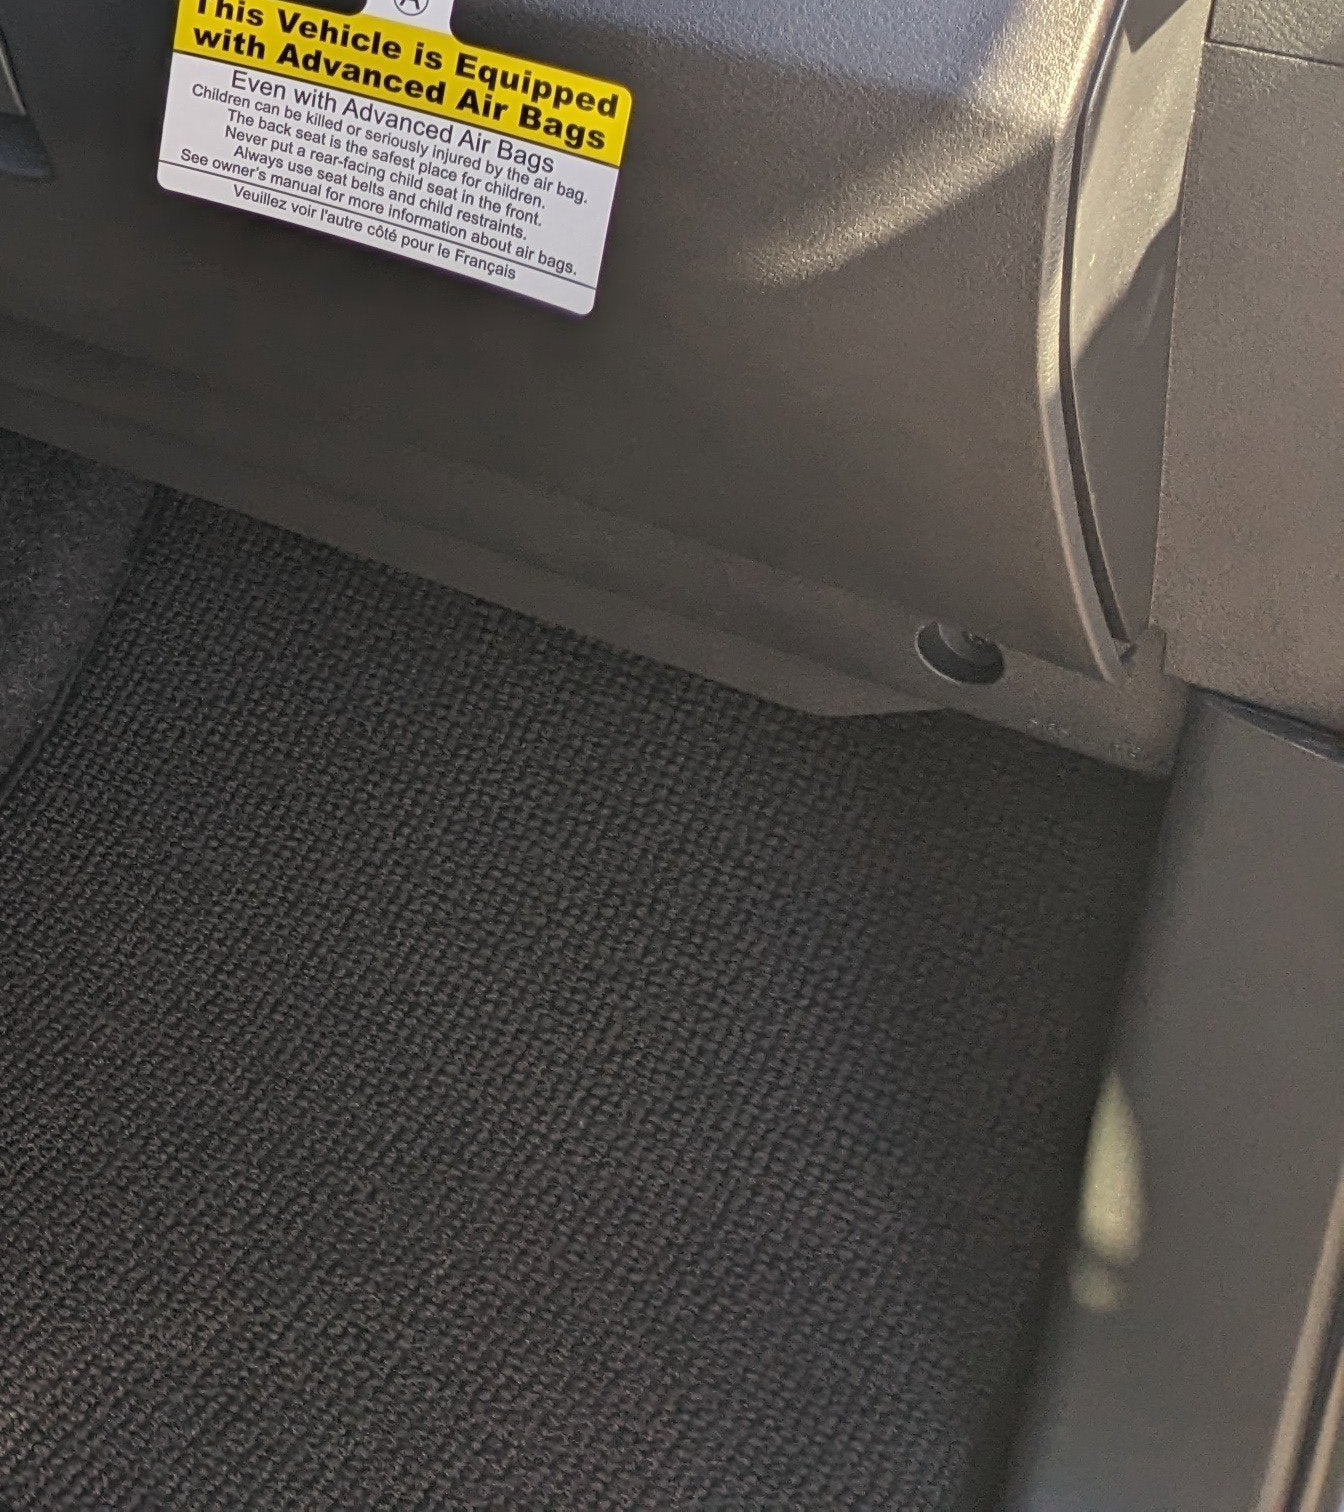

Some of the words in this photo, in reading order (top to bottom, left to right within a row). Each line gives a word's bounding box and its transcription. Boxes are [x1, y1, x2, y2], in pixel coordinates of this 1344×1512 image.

[193, 27, 266, 61] with
[276, 43, 446, 106] Advanced
[455, 88, 510, 122] Air
[518, 103, 607, 150] Bags
[277, 8, 402, 60] Vehicle
[413, 41, 443, 71] is
[454, 52, 619, 120] Equipped
[192, 83, 251, 109] Children
[254, 100, 280, 116] can
[284, 104, 302, 122] be
[306, 109, 343, 133] killed
[346, 125, 362, 137] or
[365, 129, 429, 157] seriously
[432, 146, 481, 171] injured
[485, 162, 504, 181] by
[506, 167, 530, 186] the
[533, 173, 553, 193] air
[556, 181, 588, 206] bag.
[227, 109, 254, 127] The
[258, 114, 292, 137] back
[295, 127, 326, 146] seat
[329, 134, 342, 149] is
[345, 138, 368, 157] the
[372, 146, 416, 170] safest
[419, 160, 458, 183] place
[461, 171, 482, 189] for
[485, 179, 546, 209] children.
[231, 69, 286, 100] Even
[294, 87, 337, 113] with
[341, 97, 454, 144] Advanced
[458, 129, 490, 155] Air
[496, 138, 555, 175] Bags
[180, 148, 209, 166] See
[212, 157, 267, 182] owner's
[270, 172, 322, 197] manual
[325, 186, 346, 202] for
[348, 197, 384, 214] more
[388, 205, 467, 240] information
[471, 231, 513, 255] about
[515, 244, 536, 262] air
[538, 249, 578, 277] bags.
[225, 125, 268, 147] Never
[270, 137, 293, 155] put
[296, 146, 306, 158] a
[310, 149, 386, 182] rear-facing
[389, 168, 423, 191] child
[427, 181, 459, 202] seat
[462, 188, 474, 204] in
[479, 192, 502, 213] the
[505, 205, 542, 227] front.
[233, 145, 284, 169] Always
[287, 160, 313, 176] use
[317, 167, 348, 187] seat
[351, 176, 385, 197] belts
[388, 188, 416, 207] and
[419, 193, 453, 218] child
[457, 208, 528, 241] restraints.
[233, 184, 287, 211] Veuillez
[291, 201, 318, 219] voir
[320, 208, 363, 232] l'autre
[367, 224, 398, 242] côté
[400, 236, 435, 255] pour
[437, 243, 451, 259] le
[454, 248, 517, 281] Français
